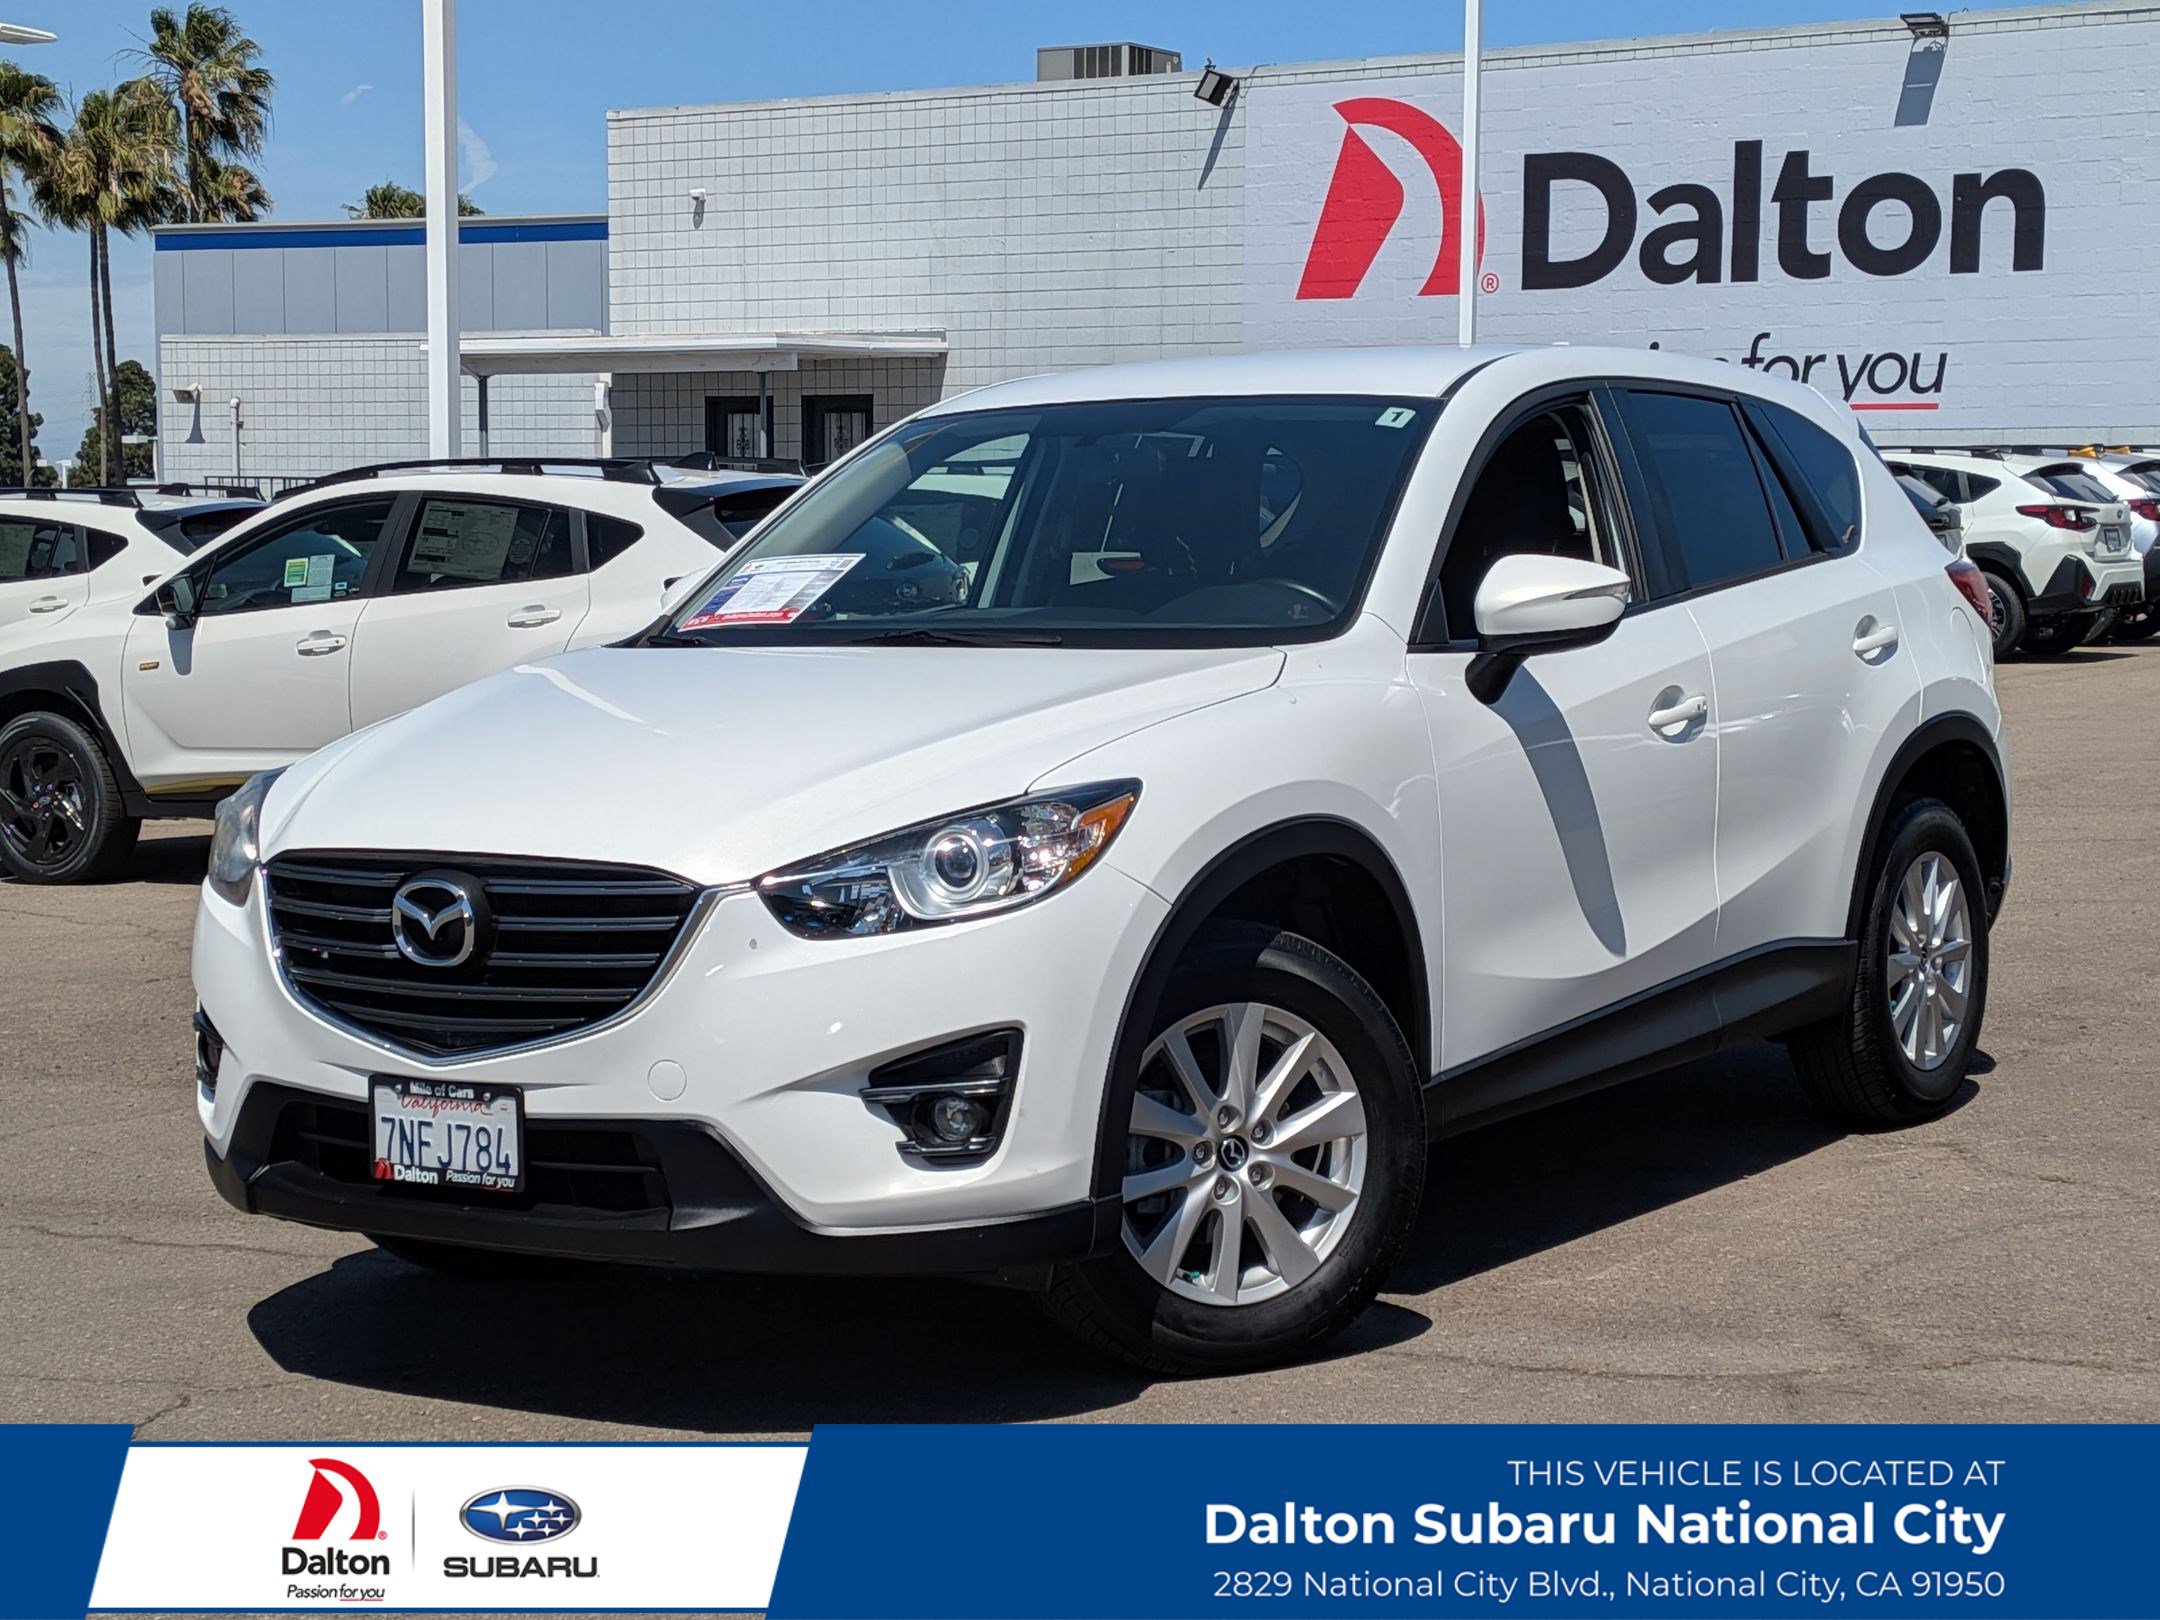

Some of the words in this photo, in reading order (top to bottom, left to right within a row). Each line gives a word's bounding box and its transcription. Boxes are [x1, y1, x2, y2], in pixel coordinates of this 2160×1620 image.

[1522, 140, 2045, 290] Dalton
[1836, 352, 1948, 403] you
[435, 1083, 446, 1097] of
[448, 1085, 475, 1100] Cars
[393, 1165, 438, 1185] Dalton
[445, 1170, 481, 1185] Passion
[481, 1172, 496, 1187] for
[496, 1177, 515, 1189] you
